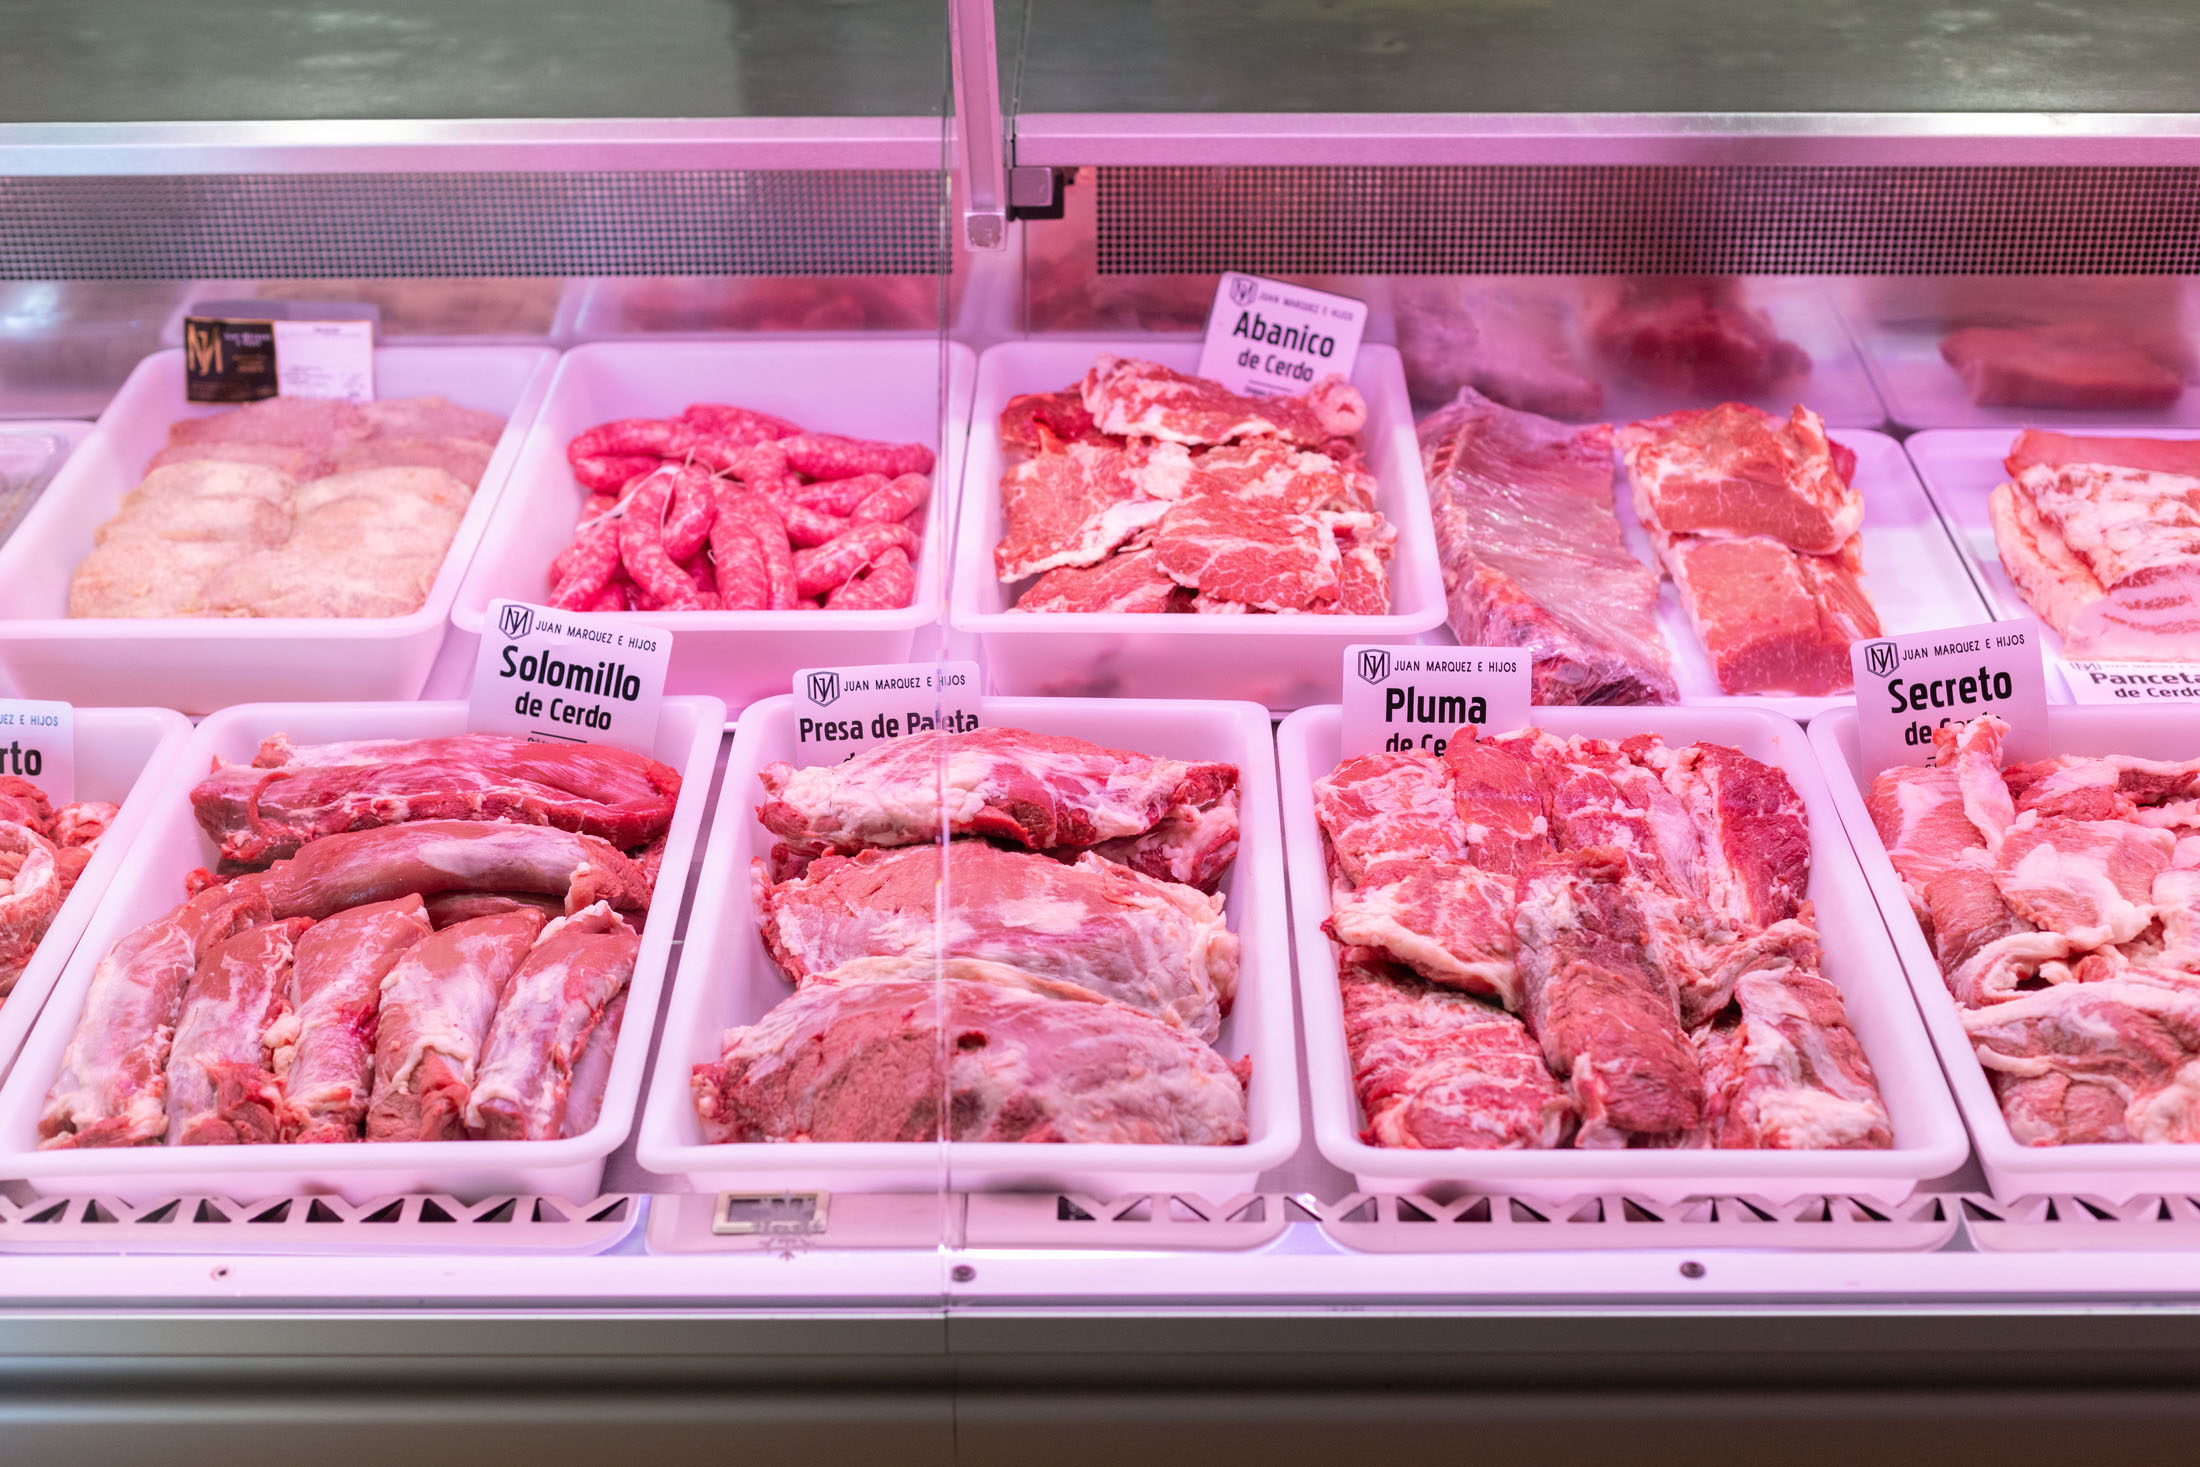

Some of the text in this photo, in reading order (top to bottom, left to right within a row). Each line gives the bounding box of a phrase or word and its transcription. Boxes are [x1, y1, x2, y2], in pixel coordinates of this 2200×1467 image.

[1233, 311, 1335, 358] Abanico
[1238, 349, 1314, 382] de Cerdo
[535, 620, 657, 652] JUAN MARQUEZ E HIJOS
[1902, 633, 2025, 661] JUAN MARQUEZ E HIJOS
[499, 645, 641, 701] Solomillo
[1394, 660, 1517, 673] JUAN MARQUEZ E HIJOS
[843, 674, 966, 692] JUAN MARQUEZ E HIJOS
[1887, 665, 2013, 714] Secreto
[2114, 687, 2141, 698] de
[514, 691, 612, 731] de Cerdo
[1385, 685, 1487, 724] Pluma
[20, 714, 25, 725] E
[31, 715, 59, 727] HIJOS
[799, 717, 864, 743] Presa
[871, 712, 900, 739] de
[1904, 720, 1932, 746] de
[1385, 732, 1413, 752] de
